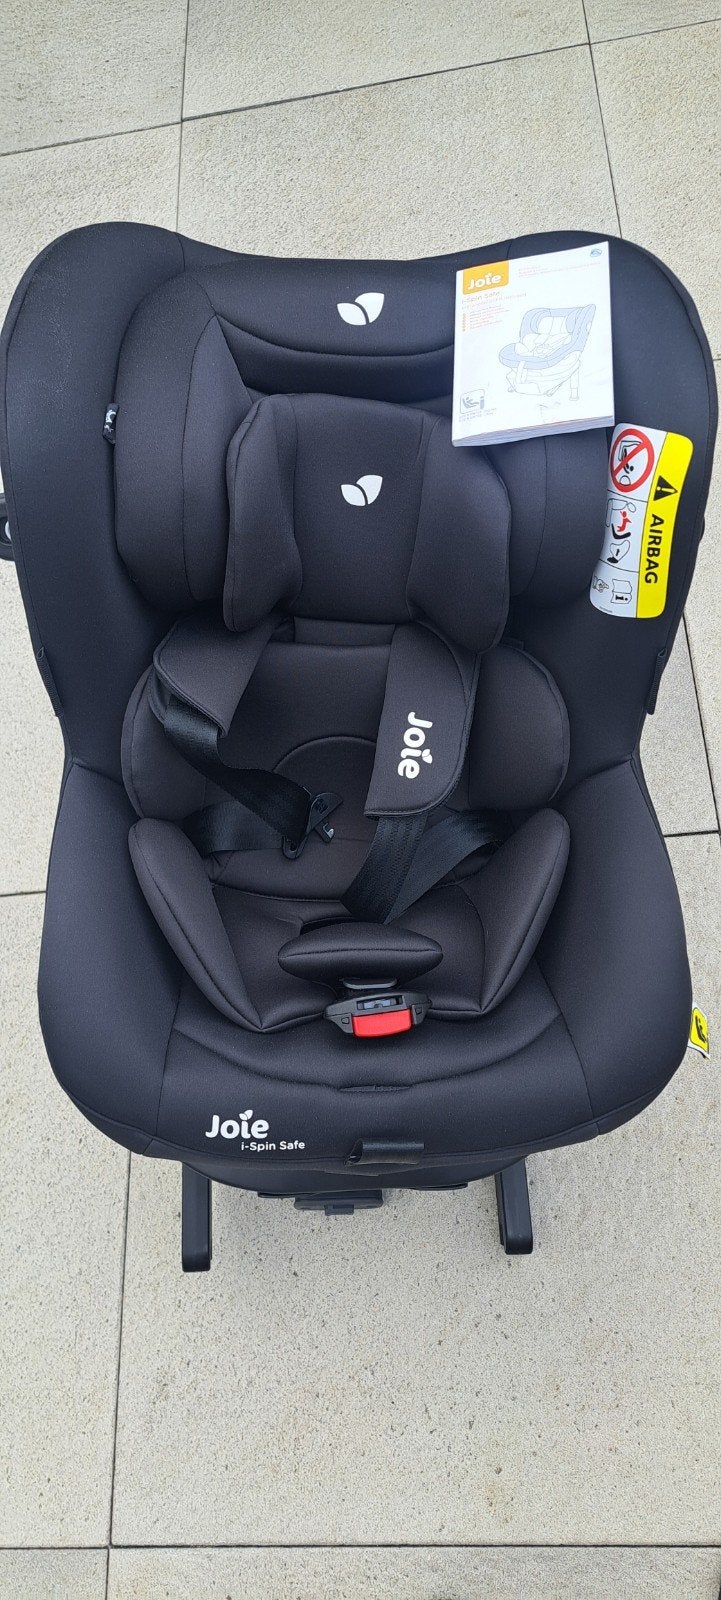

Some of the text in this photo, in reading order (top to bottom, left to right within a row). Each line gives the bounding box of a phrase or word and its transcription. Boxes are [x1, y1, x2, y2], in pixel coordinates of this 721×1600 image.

[467, 272, 502, 290] Joie
[644, 514, 665, 584] AIRBAG
[397, 711, 433, 779] Joie
[205, 1109, 270, 1139] Joie
[241, 1140, 305, 1152] i-Spin Safe
